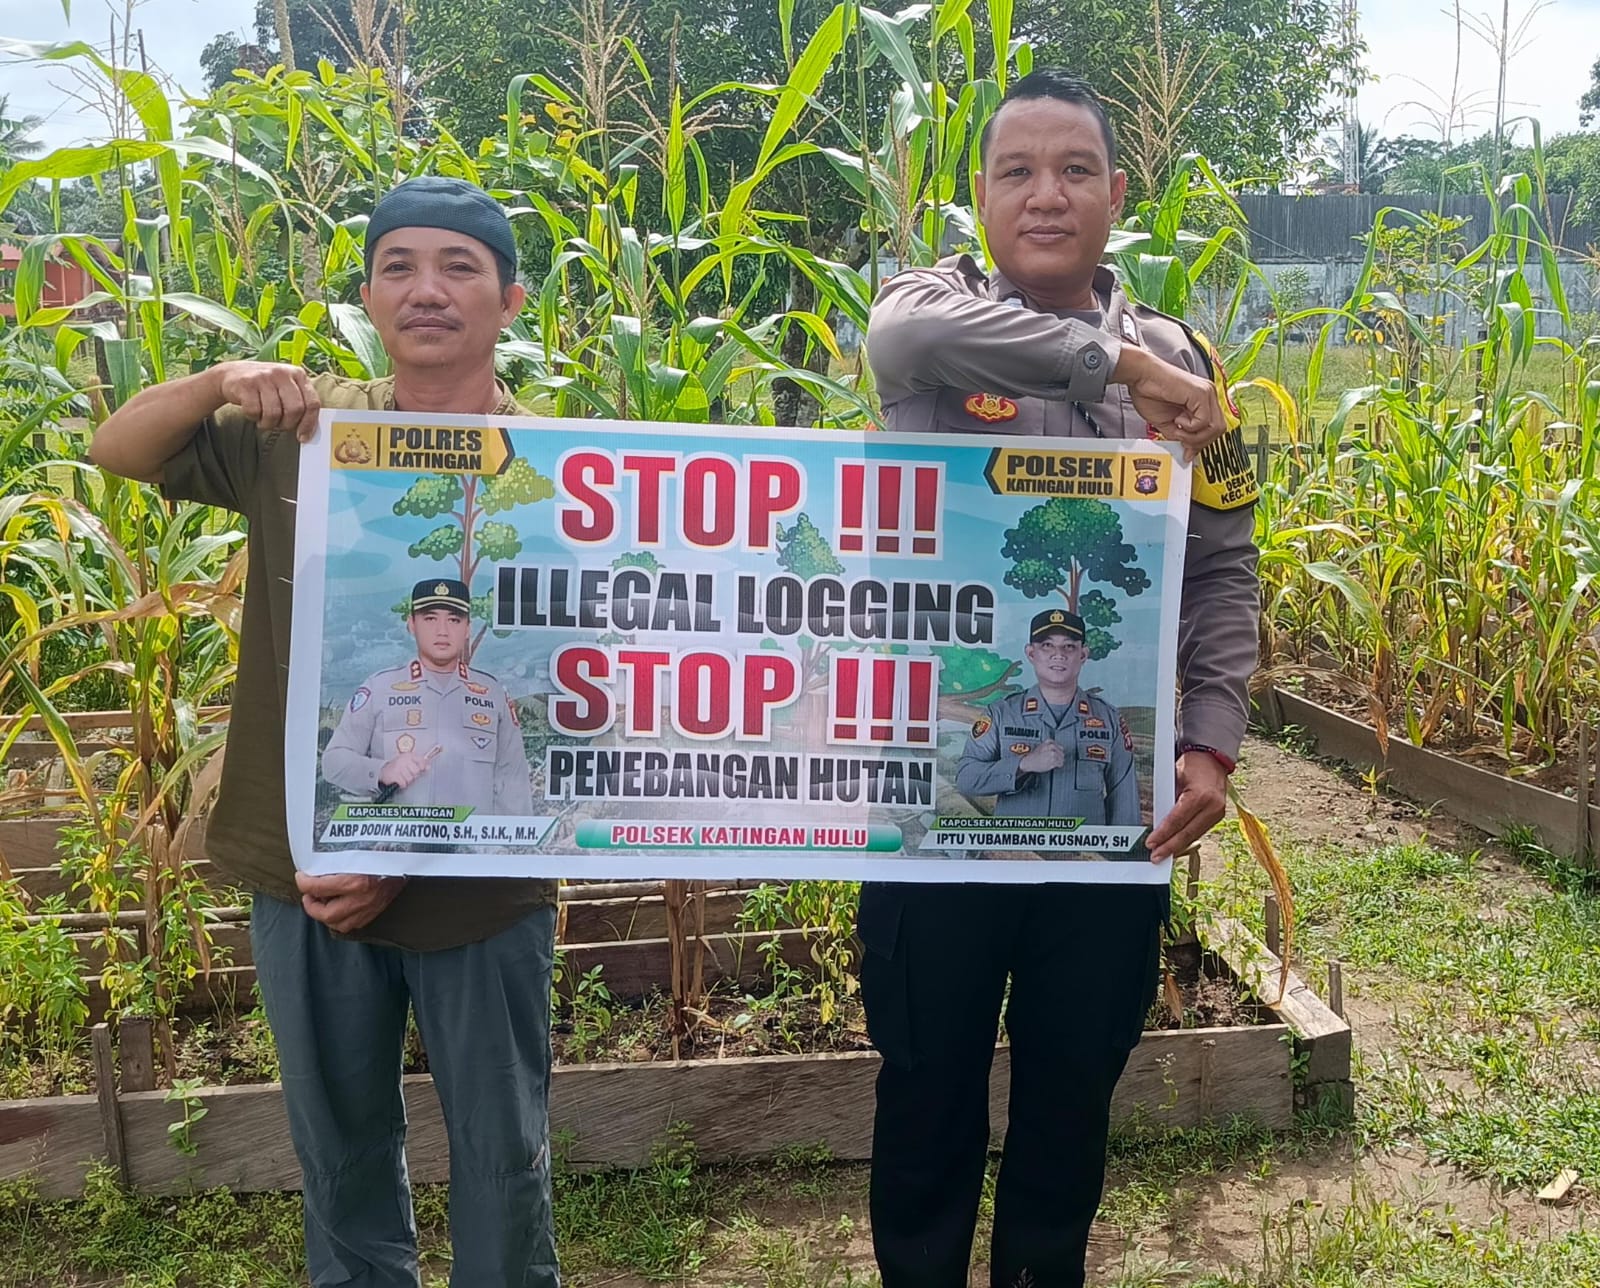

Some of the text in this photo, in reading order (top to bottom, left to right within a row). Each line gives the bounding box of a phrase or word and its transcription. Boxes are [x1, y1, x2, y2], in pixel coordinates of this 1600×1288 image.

[389, 426, 482, 452] POLRES
[389, 451, 482, 470] KATINGAN
[1007, 454, 1113, 479] POLSEK
[1006, 477, 1114, 496] KATINGAN HULU
[560, 451, 940, 556] STOP !!!
[496, 565, 995, 646] ILLEGAL LOGGING
[388, 695, 422, 706] DODIK
[464, 695, 495, 709] POLRI
[555, 646, 933, 745] STOP !!!
[1080, 730, 1110, 740] POLRI
[549, 749, 933, 806] PENEBANGAN HUTAN
[348, 807, 454, 819] KAPOLRES KATINGAN
[329, 823, 359, 838] AKBP
[360, 823, 392, 837] DODIK
[393, 824, 451, 841] HARTONO,
[514, 827, 539, 841] M.H.
[940, 818, 1076, 829] KAPOLSEK KATINGAN HULU
[611, 825, 868, 847] POLSEK KATINGAN HULU
[936, 833, 1129, 850] IPTU YUBAMBANG KUSNADY, SH
